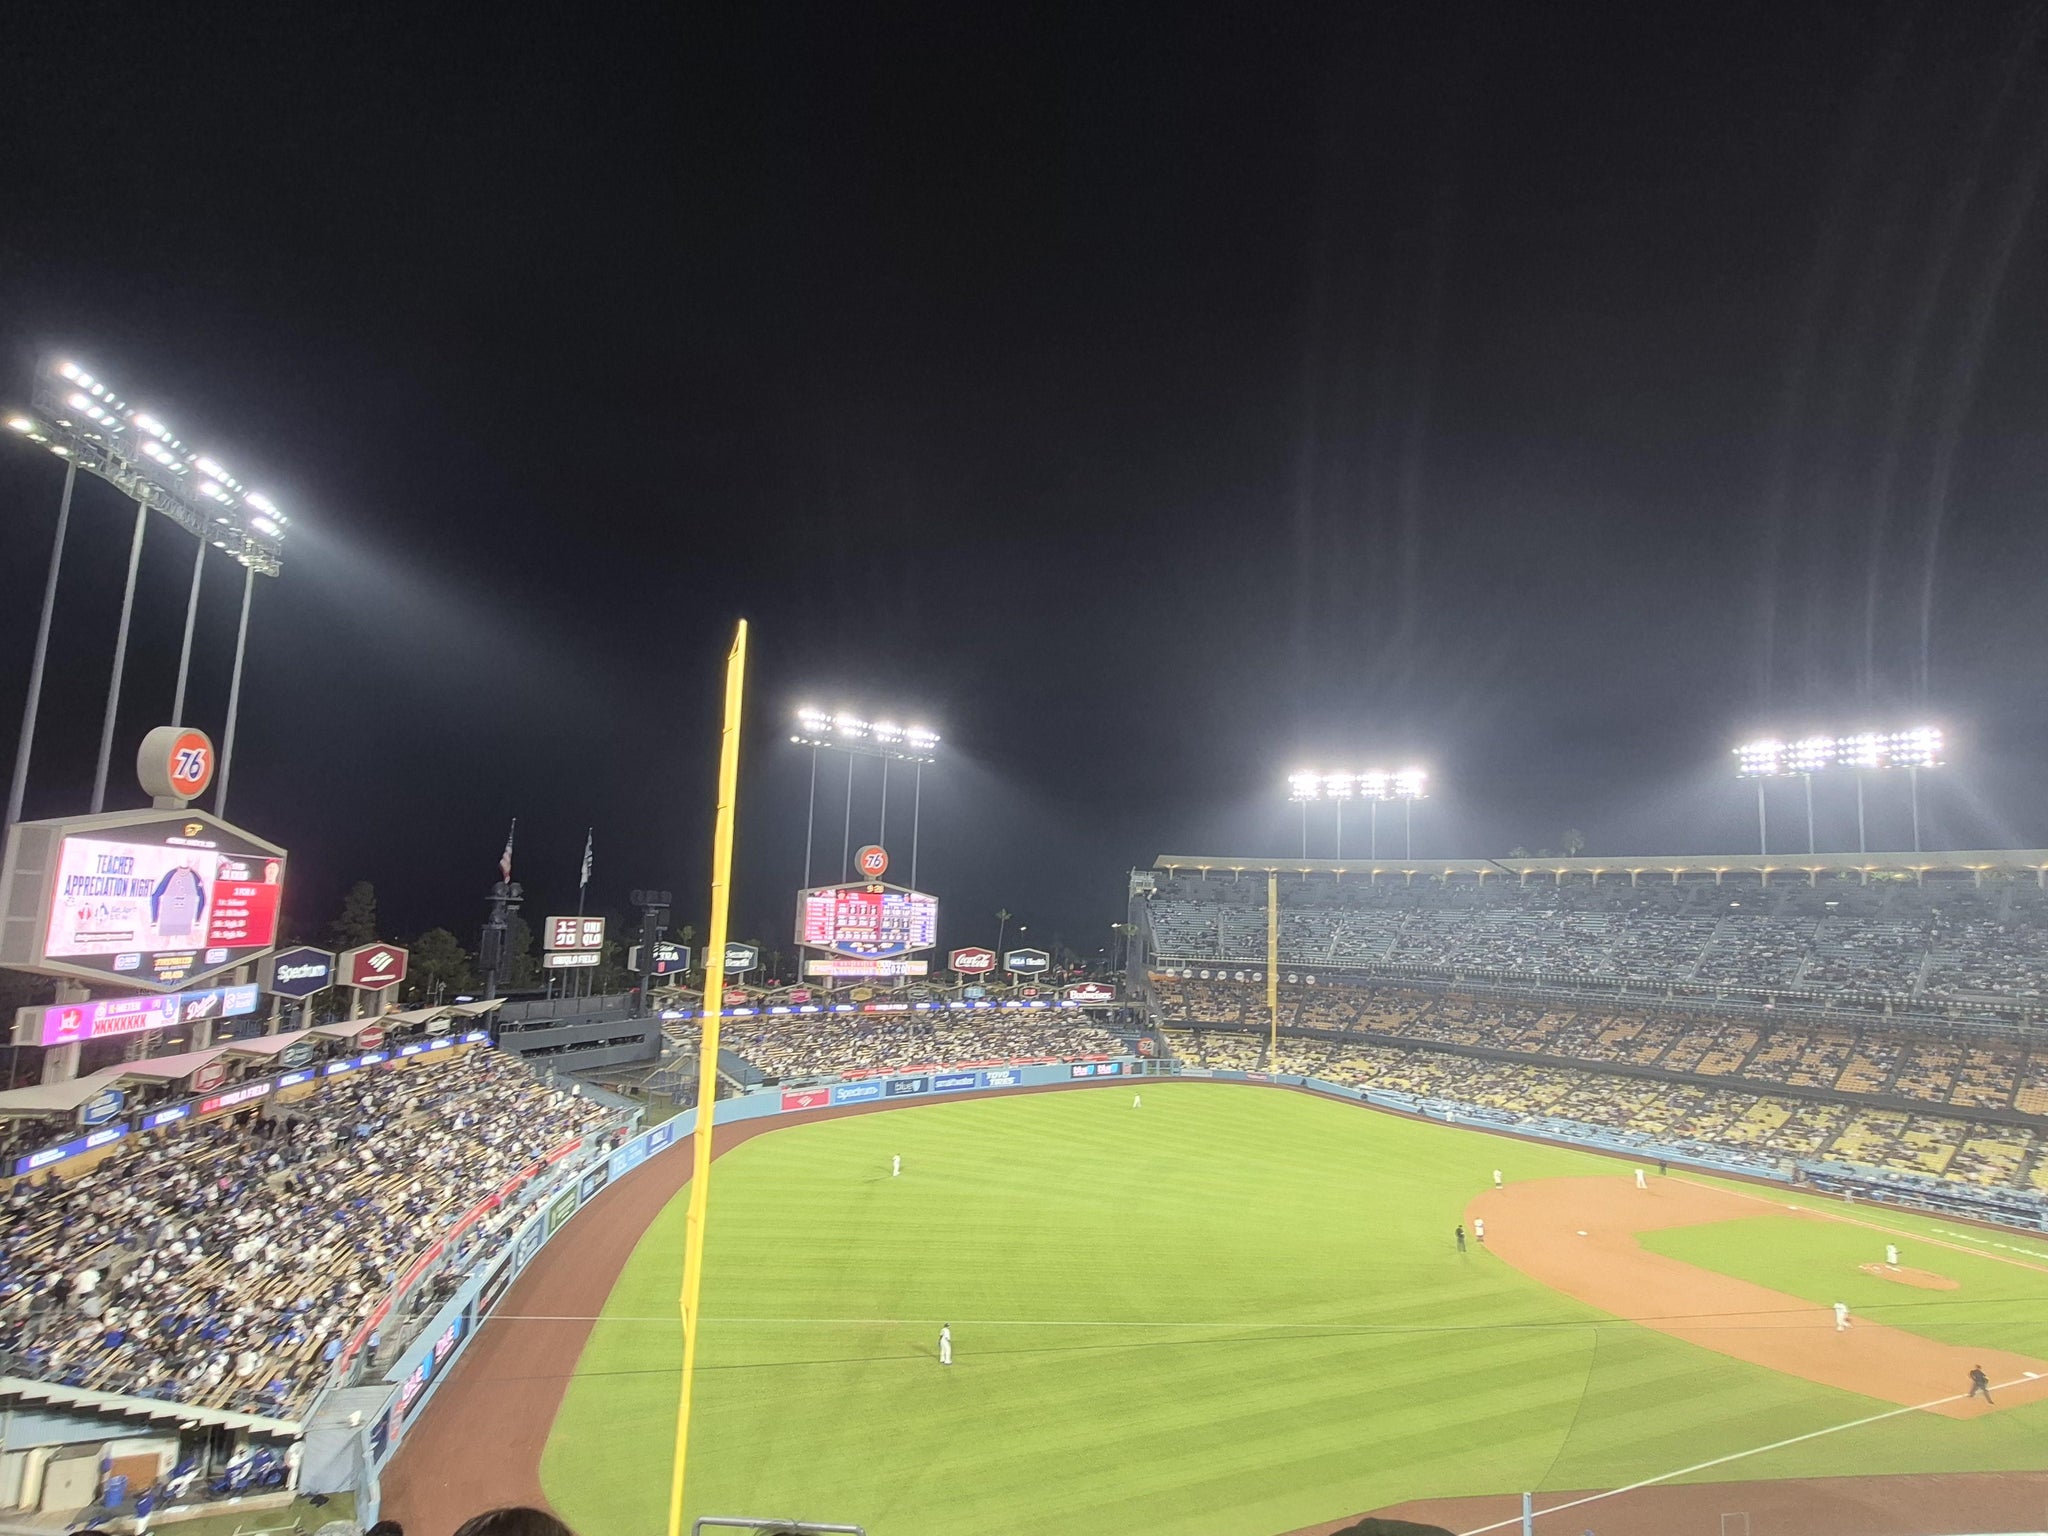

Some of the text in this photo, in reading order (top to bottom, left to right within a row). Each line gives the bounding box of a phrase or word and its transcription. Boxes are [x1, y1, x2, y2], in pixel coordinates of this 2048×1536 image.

[173, 748, 207, 783] 76
[97, 854, 135, 875] TEACHER
[865, 853, 884, 869] 76
[63, 875, 155, 897] APPRECIATION NIGHT
[584, 921, 602, 933] UNI
[582, 933, 602, 947] QLO
[954, 953, 992, 968] Coca-Cola
[277, 964, 327, 984] Spectrum
[1069, 990, 1112, 1000] Budweiser
[986, 1071, 1009, 1080] TOYO
[837, 1086, 878, 1100] Spectrum
